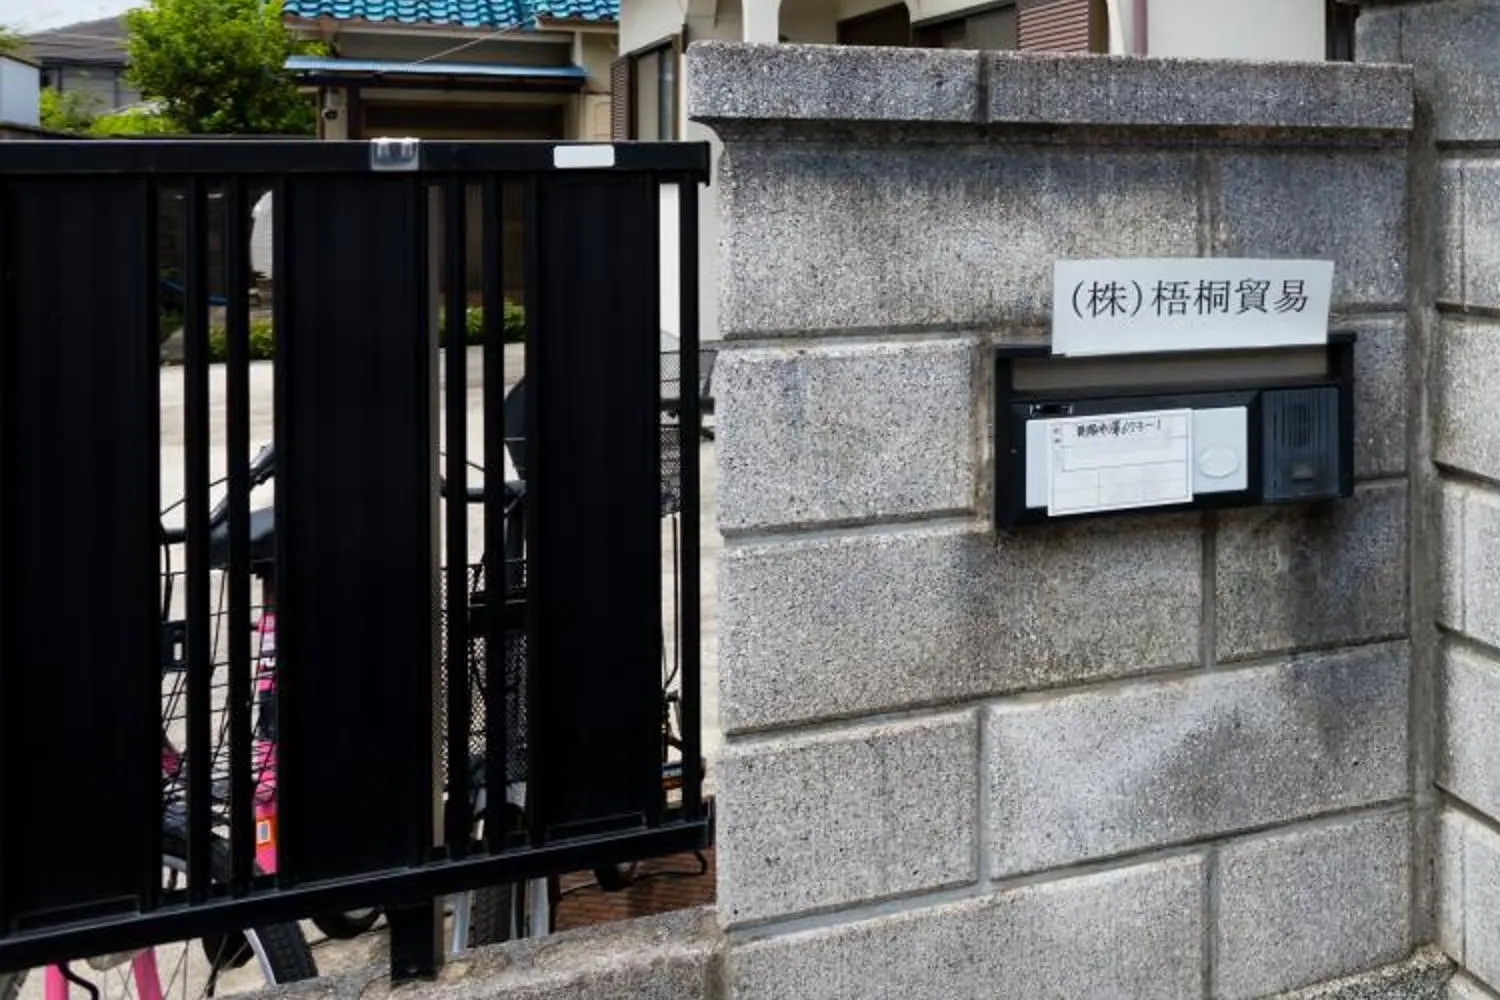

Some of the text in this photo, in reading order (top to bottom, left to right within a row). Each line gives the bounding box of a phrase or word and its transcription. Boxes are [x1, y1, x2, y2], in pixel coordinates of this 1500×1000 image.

[1072, 278, 1309, 317] (株)梧桐貿易
